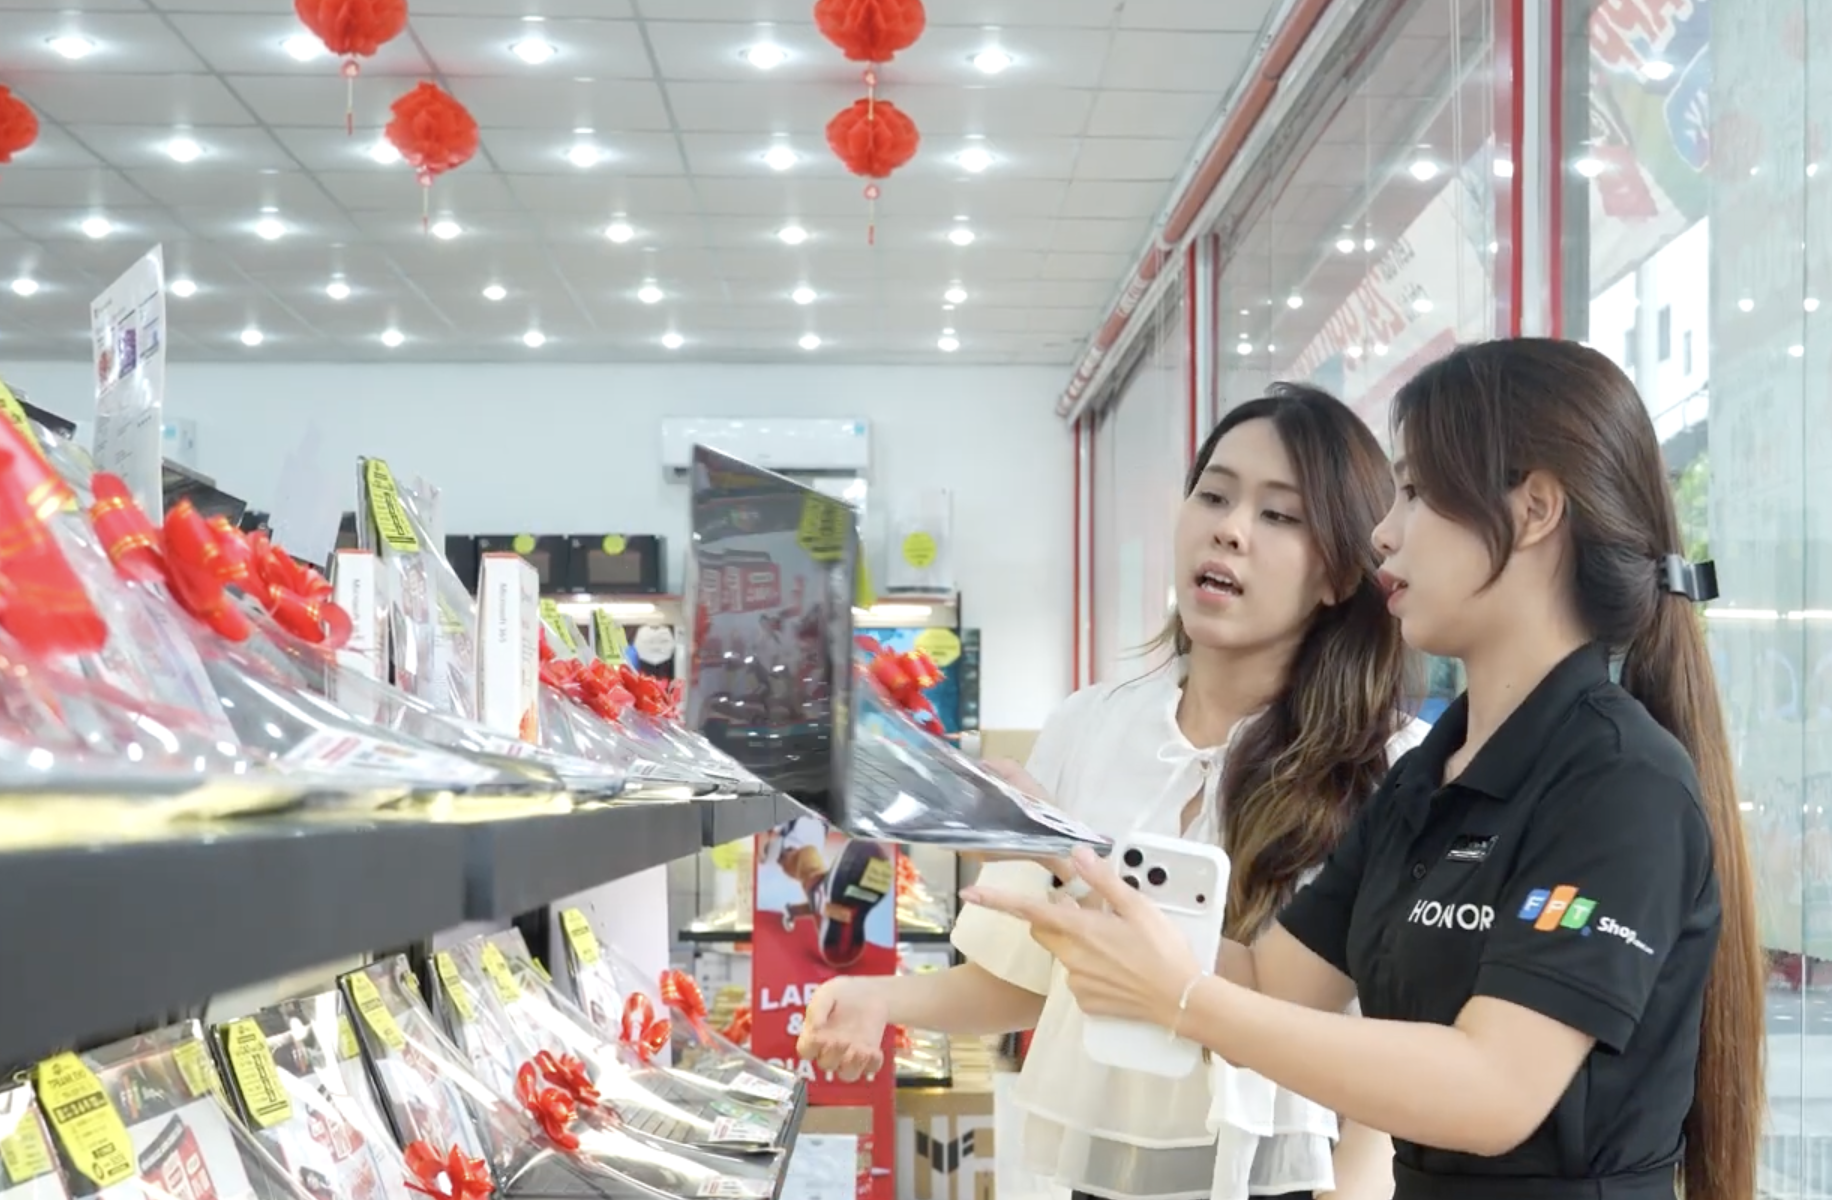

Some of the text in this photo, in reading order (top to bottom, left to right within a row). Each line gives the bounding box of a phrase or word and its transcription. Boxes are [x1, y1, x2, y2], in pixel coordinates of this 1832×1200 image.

[1408, 899, 1495, 931] HONOR
[1522, 893, 1637, 944] FPT Shop
[760, 983, 820, 1011] LAP
[786, 1012, 805, 1035] &
